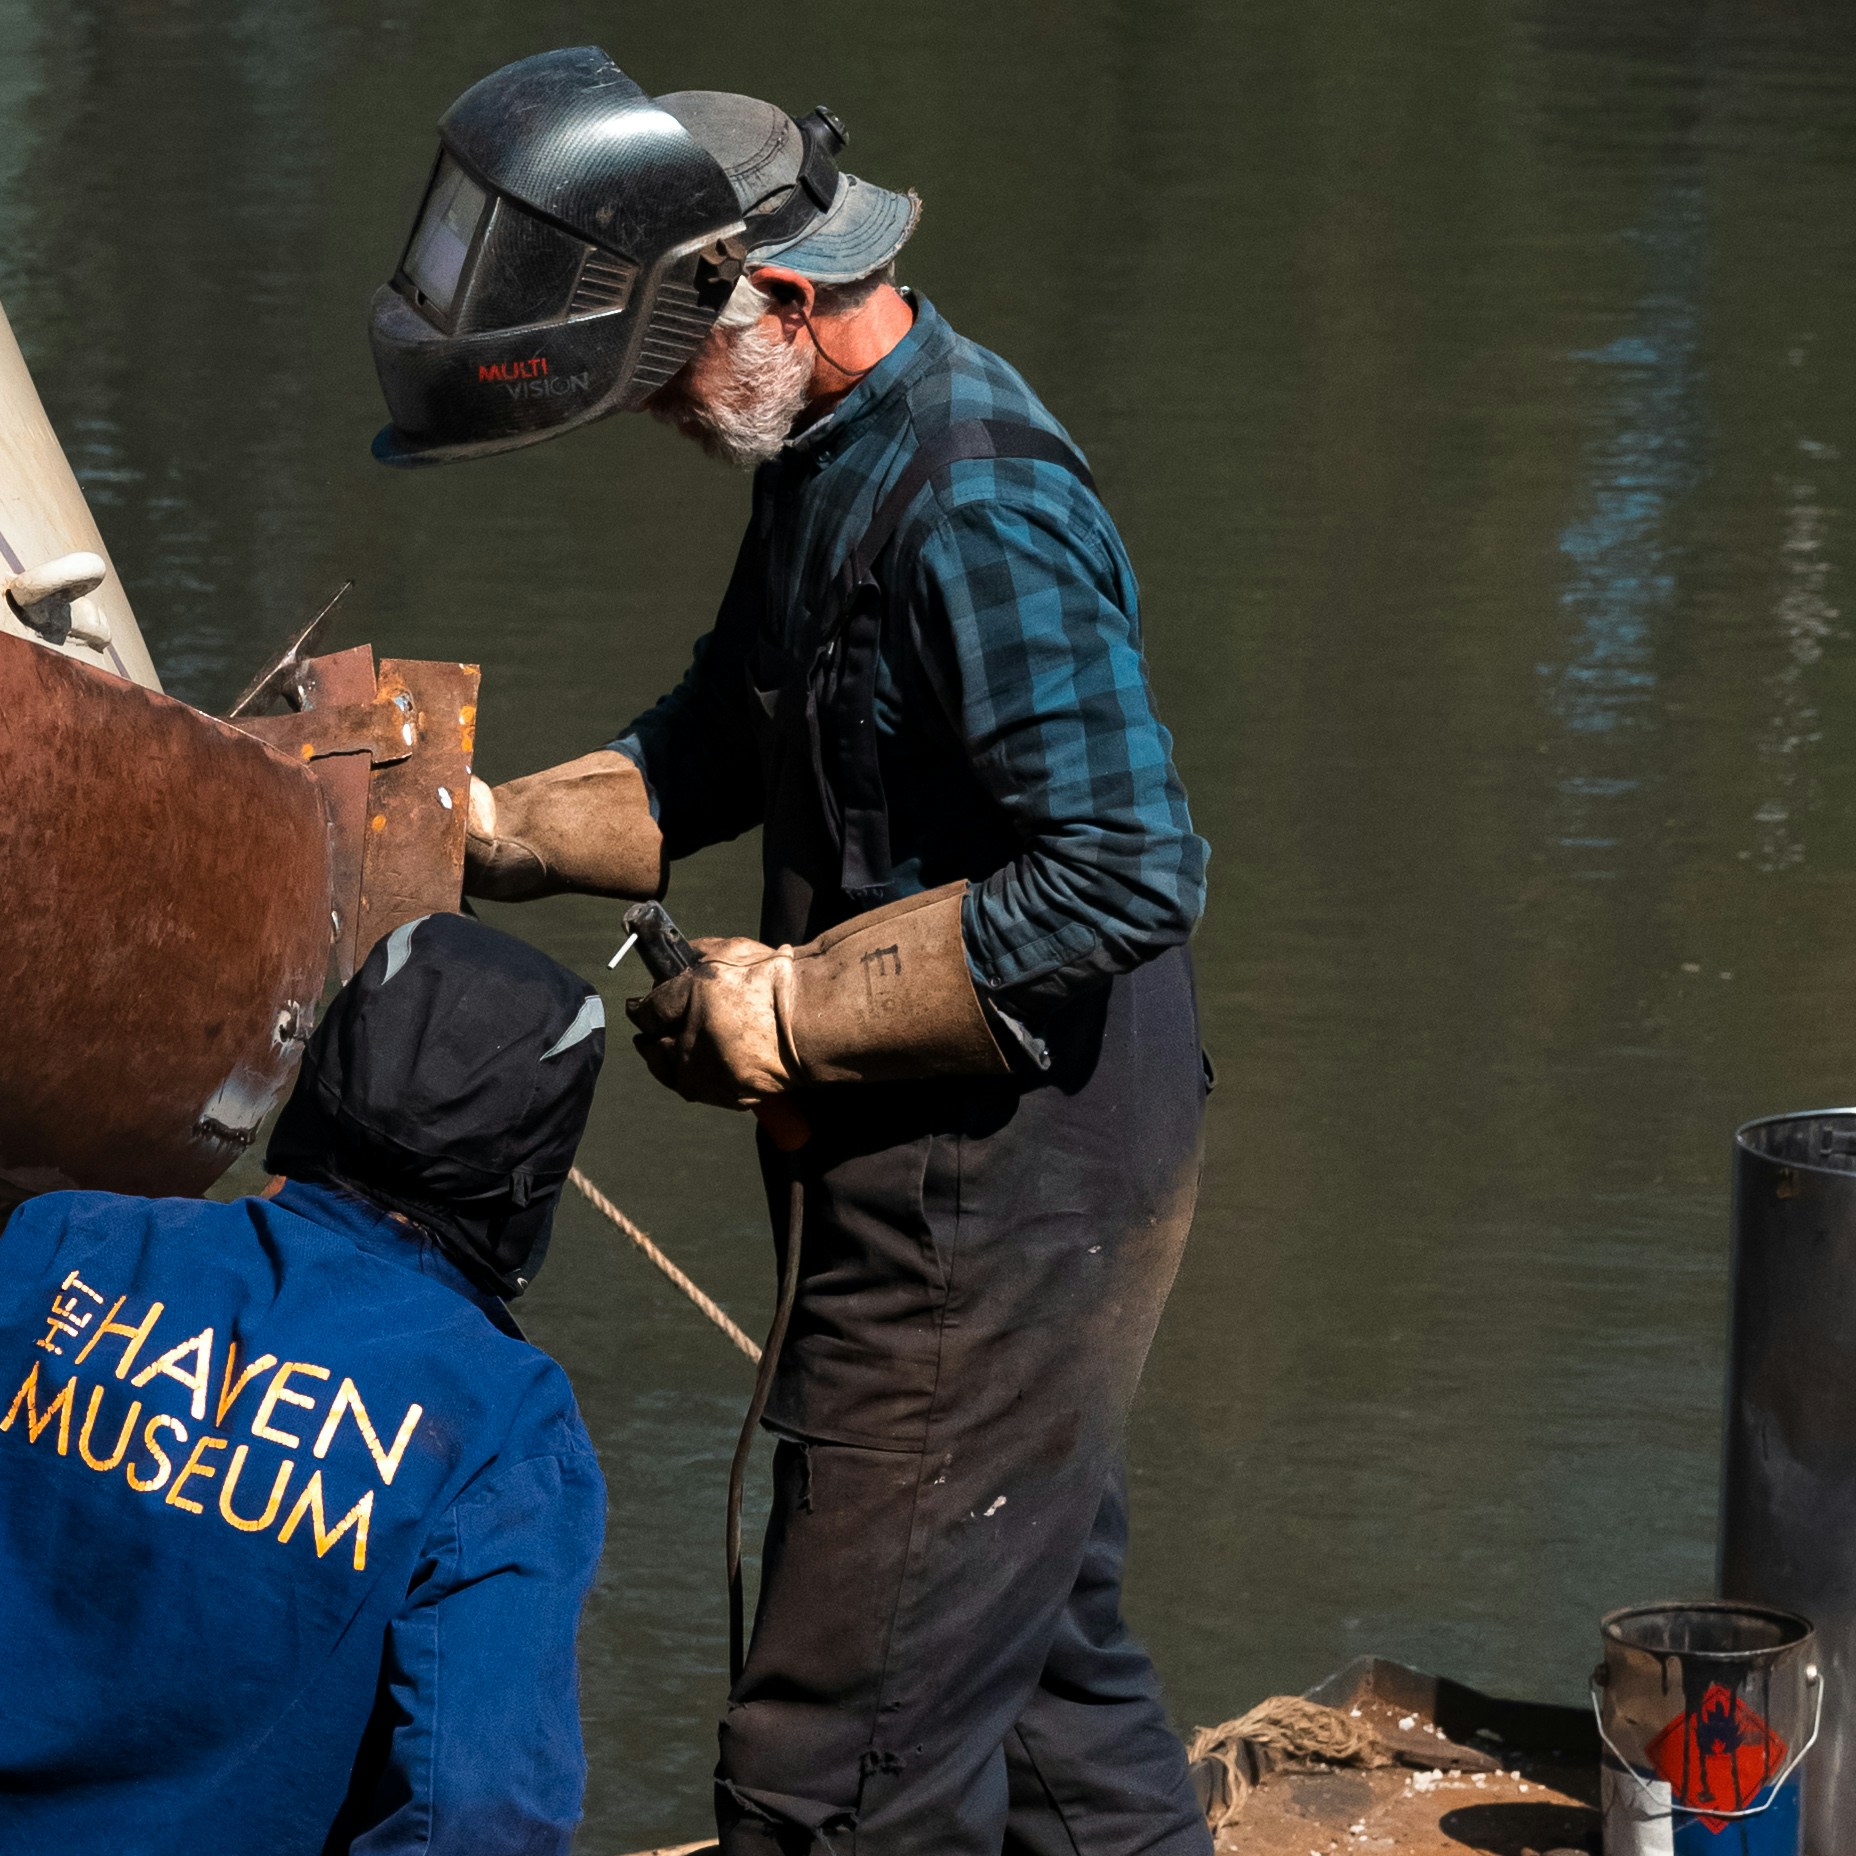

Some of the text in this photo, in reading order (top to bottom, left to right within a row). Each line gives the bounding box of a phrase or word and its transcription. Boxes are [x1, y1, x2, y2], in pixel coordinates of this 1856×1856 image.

[478, 356, 548, 383] MULTI
[505, 371, 590, 400] VISION
[36, 1269, 104, 1356] HET
[74, 1294, 424, 1486] HAVEN
